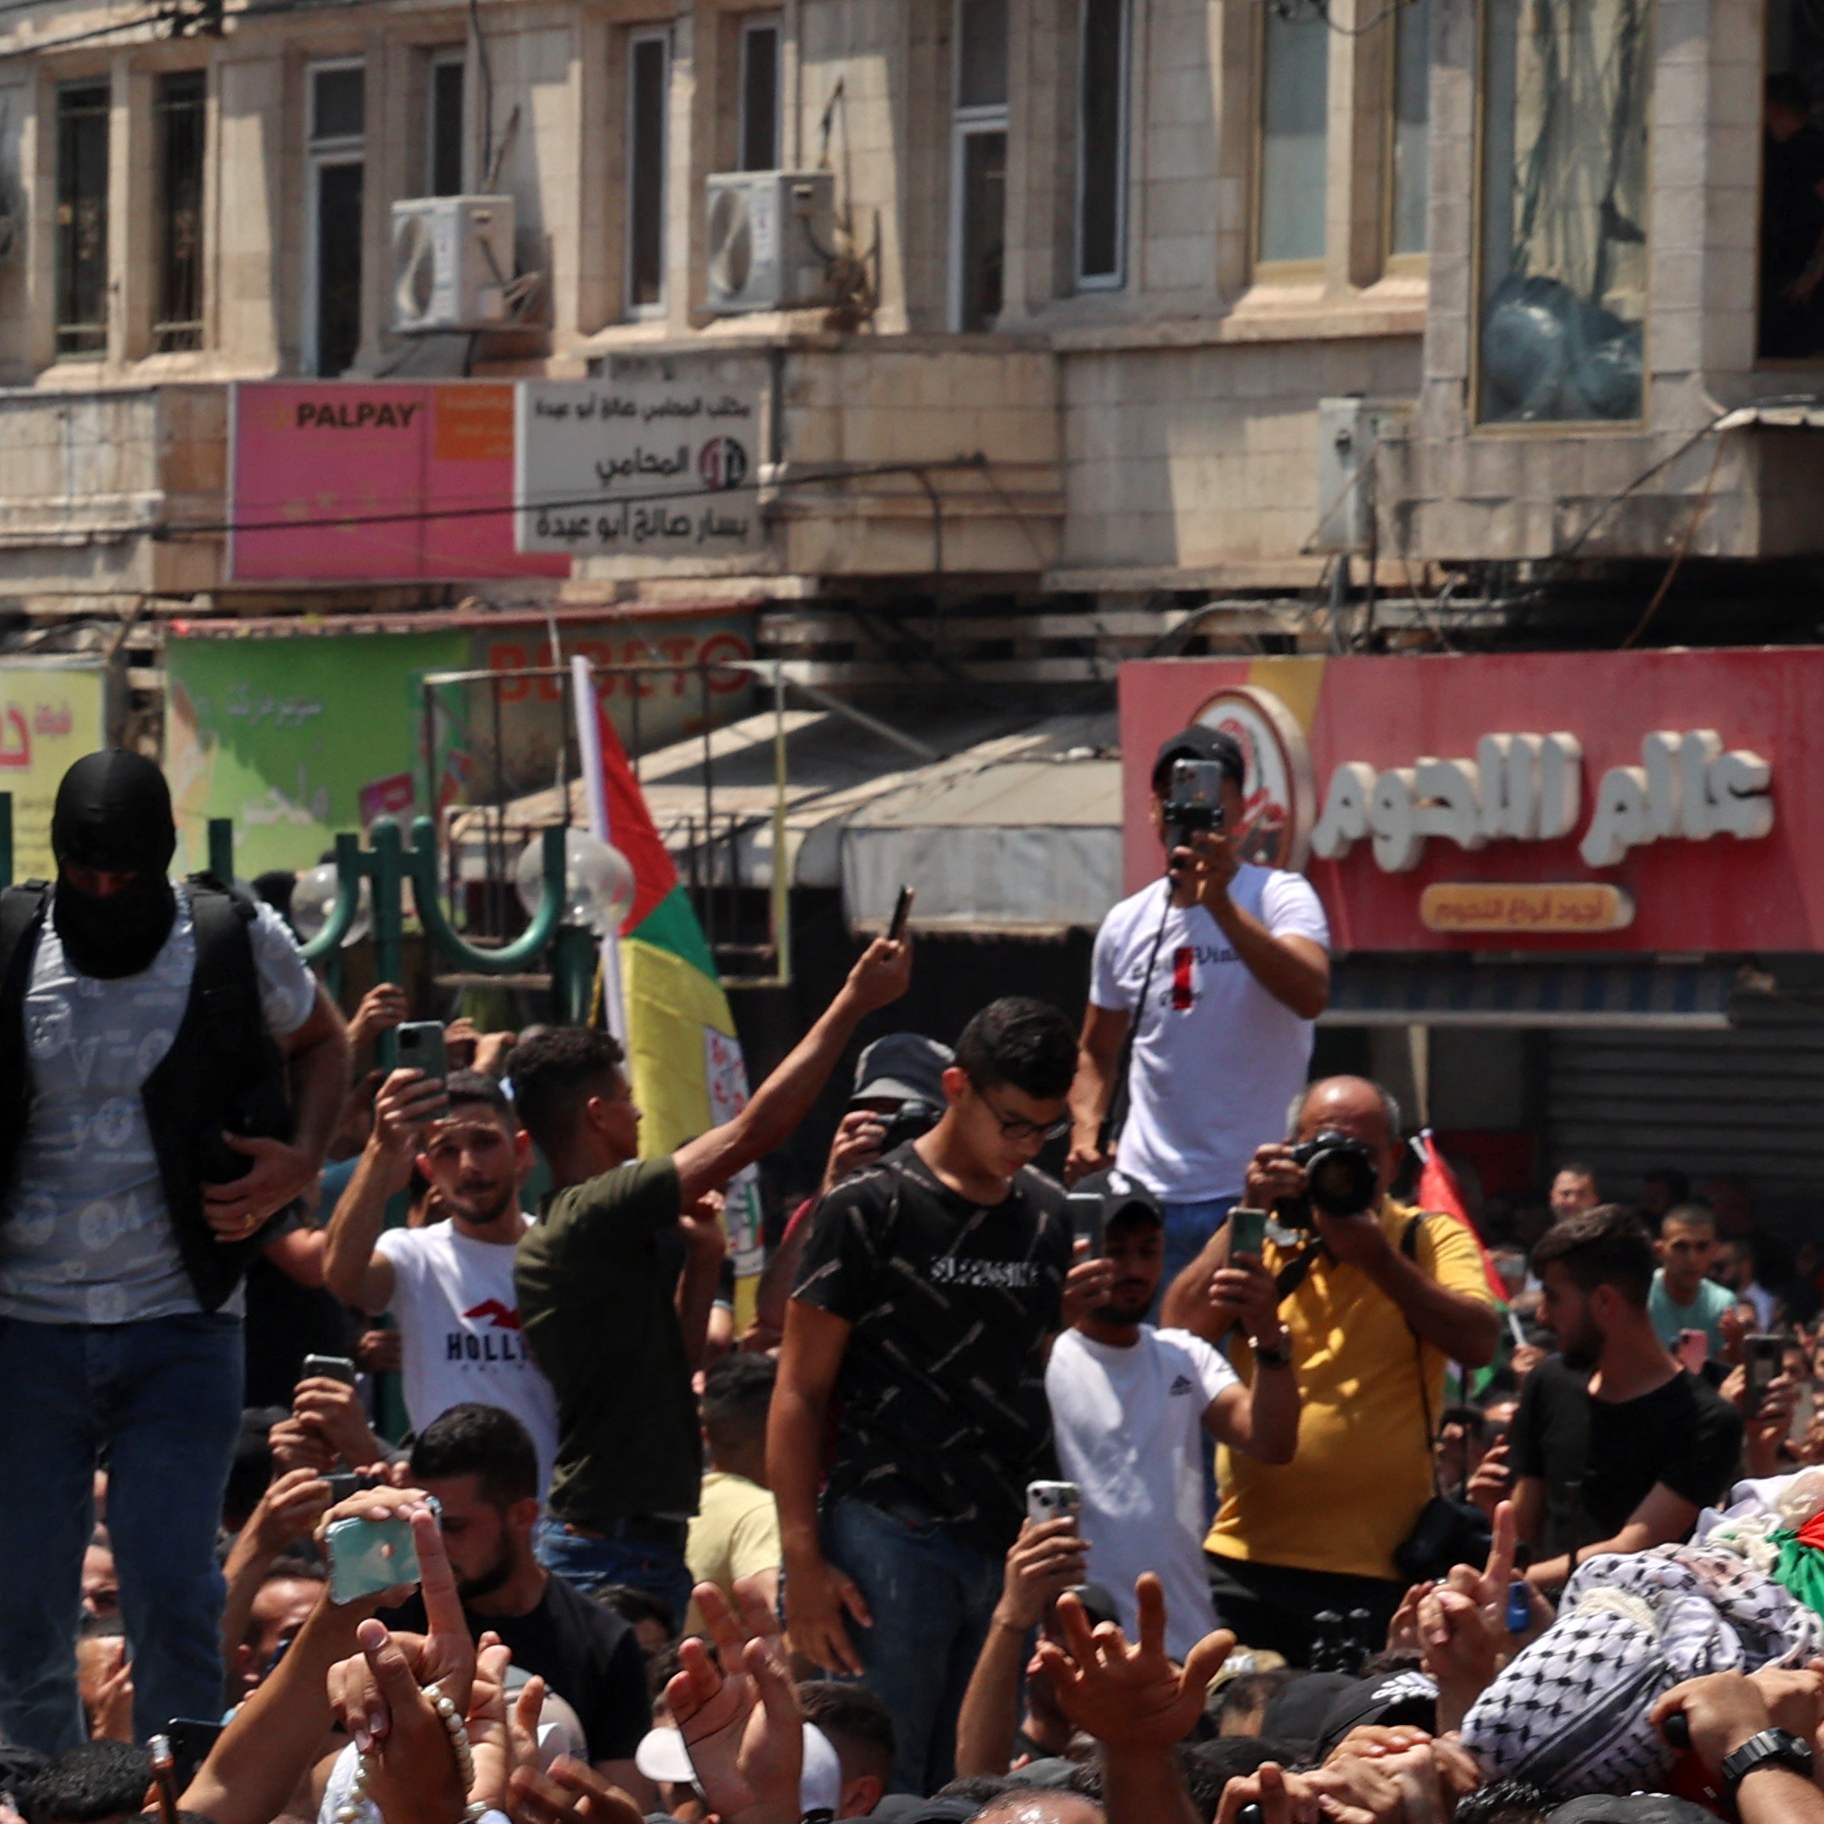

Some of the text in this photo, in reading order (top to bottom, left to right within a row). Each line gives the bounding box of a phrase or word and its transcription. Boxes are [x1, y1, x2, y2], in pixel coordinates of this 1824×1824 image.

[296, 403, 417, 428] PALPAY
[595, 445, 690, 488] المحامي
[596, 500, 629, 543] أبو
[635, 508, 692, 543] صالح
[1312, 729, 1774, 873] عالم اللحوم
